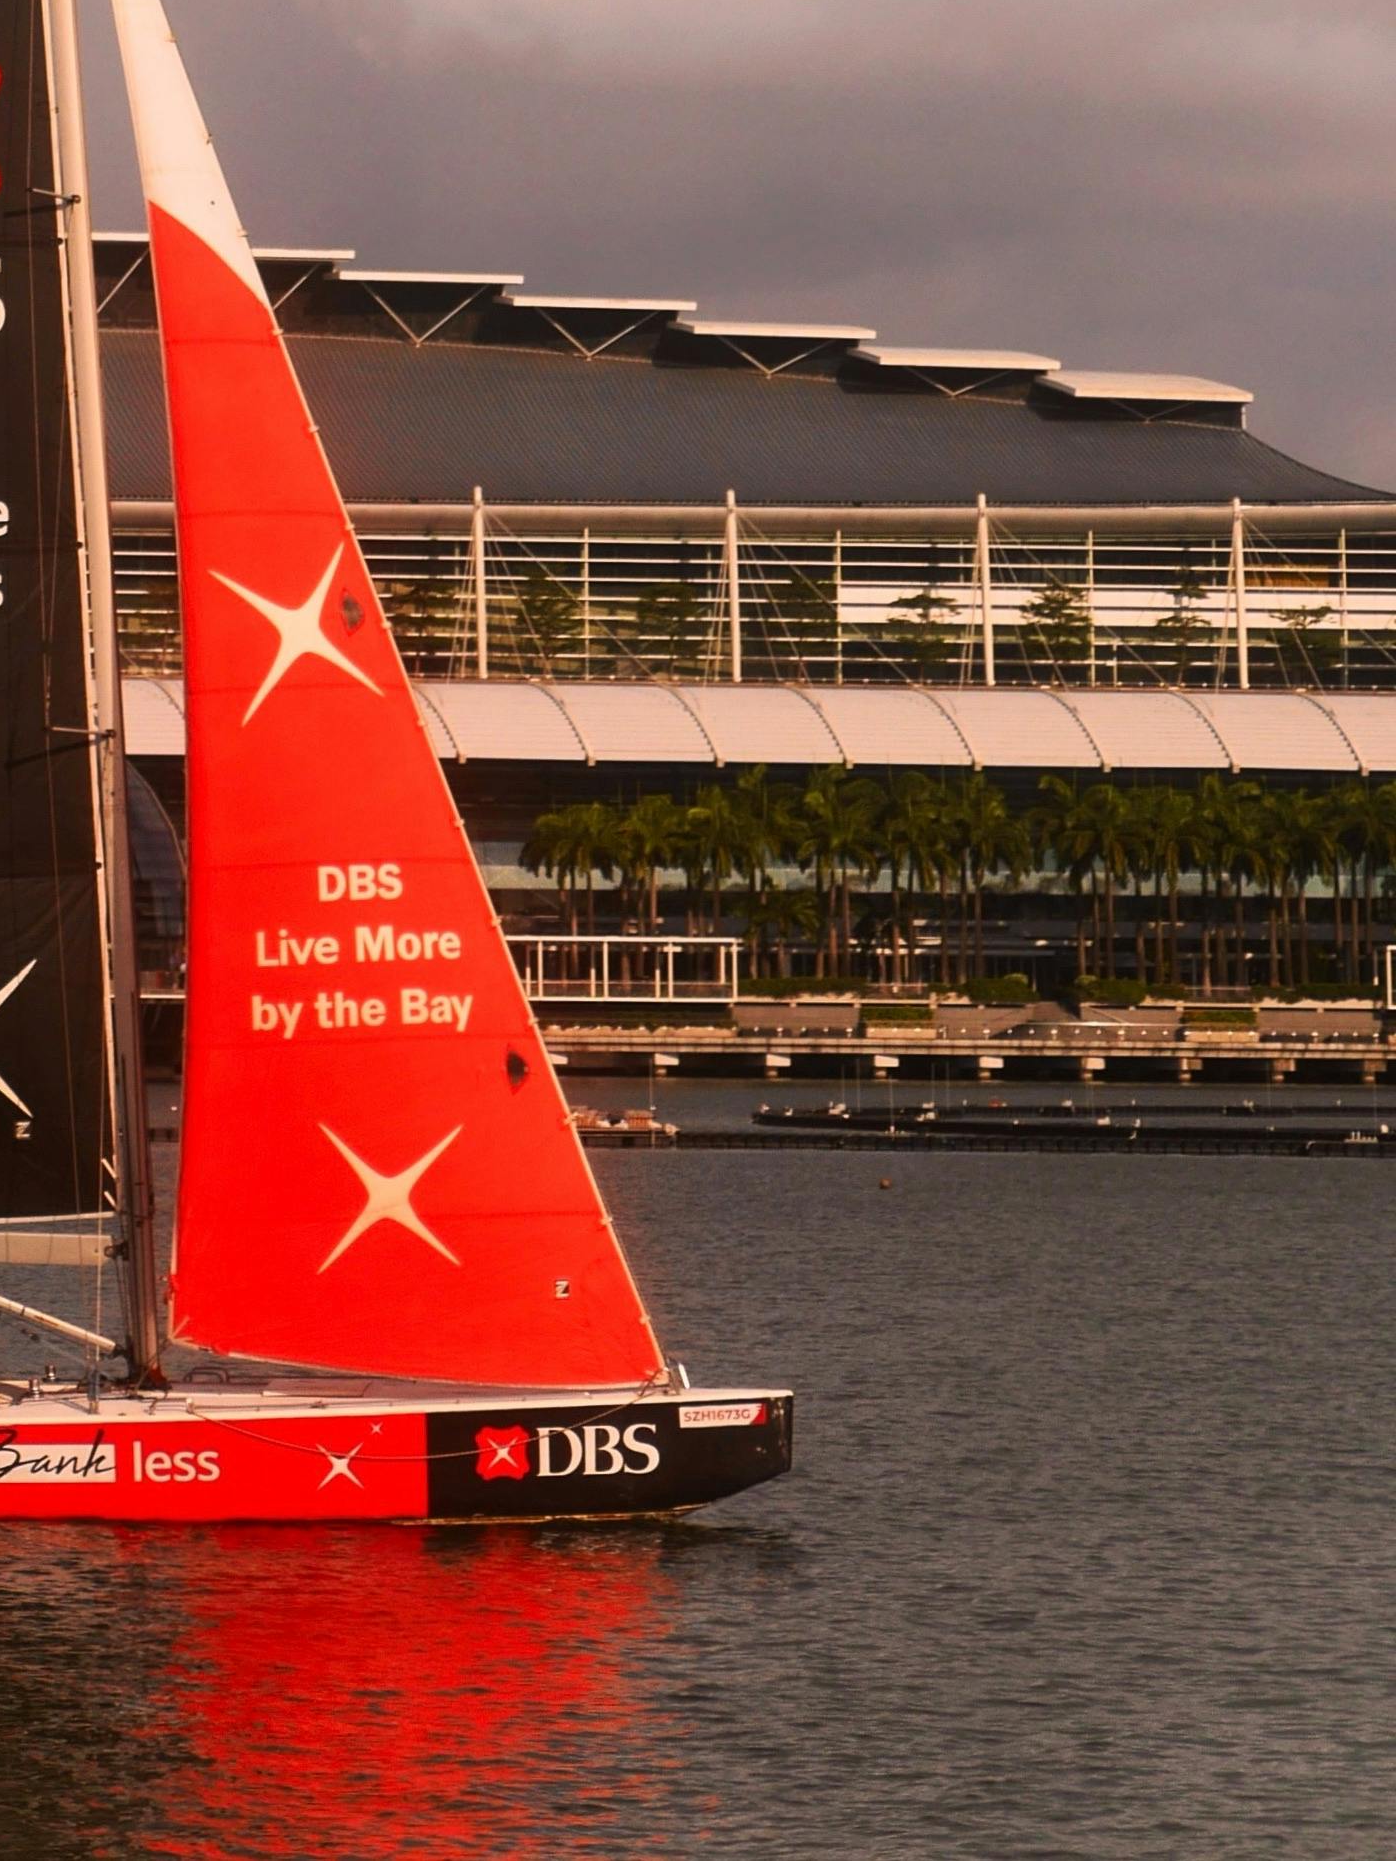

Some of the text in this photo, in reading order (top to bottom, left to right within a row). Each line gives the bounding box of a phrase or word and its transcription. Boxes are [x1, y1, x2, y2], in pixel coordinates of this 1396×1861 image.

[317, 864, 404, 902] DBS
[255, 926, 461, 967] Live More
[251, 988, 473, 1039] by the Bay
[683, 1408, 751, 1423] SZH1673G
[132, 1441, 220, 1483] less
[536, 1423, 661, 1477] DBS
